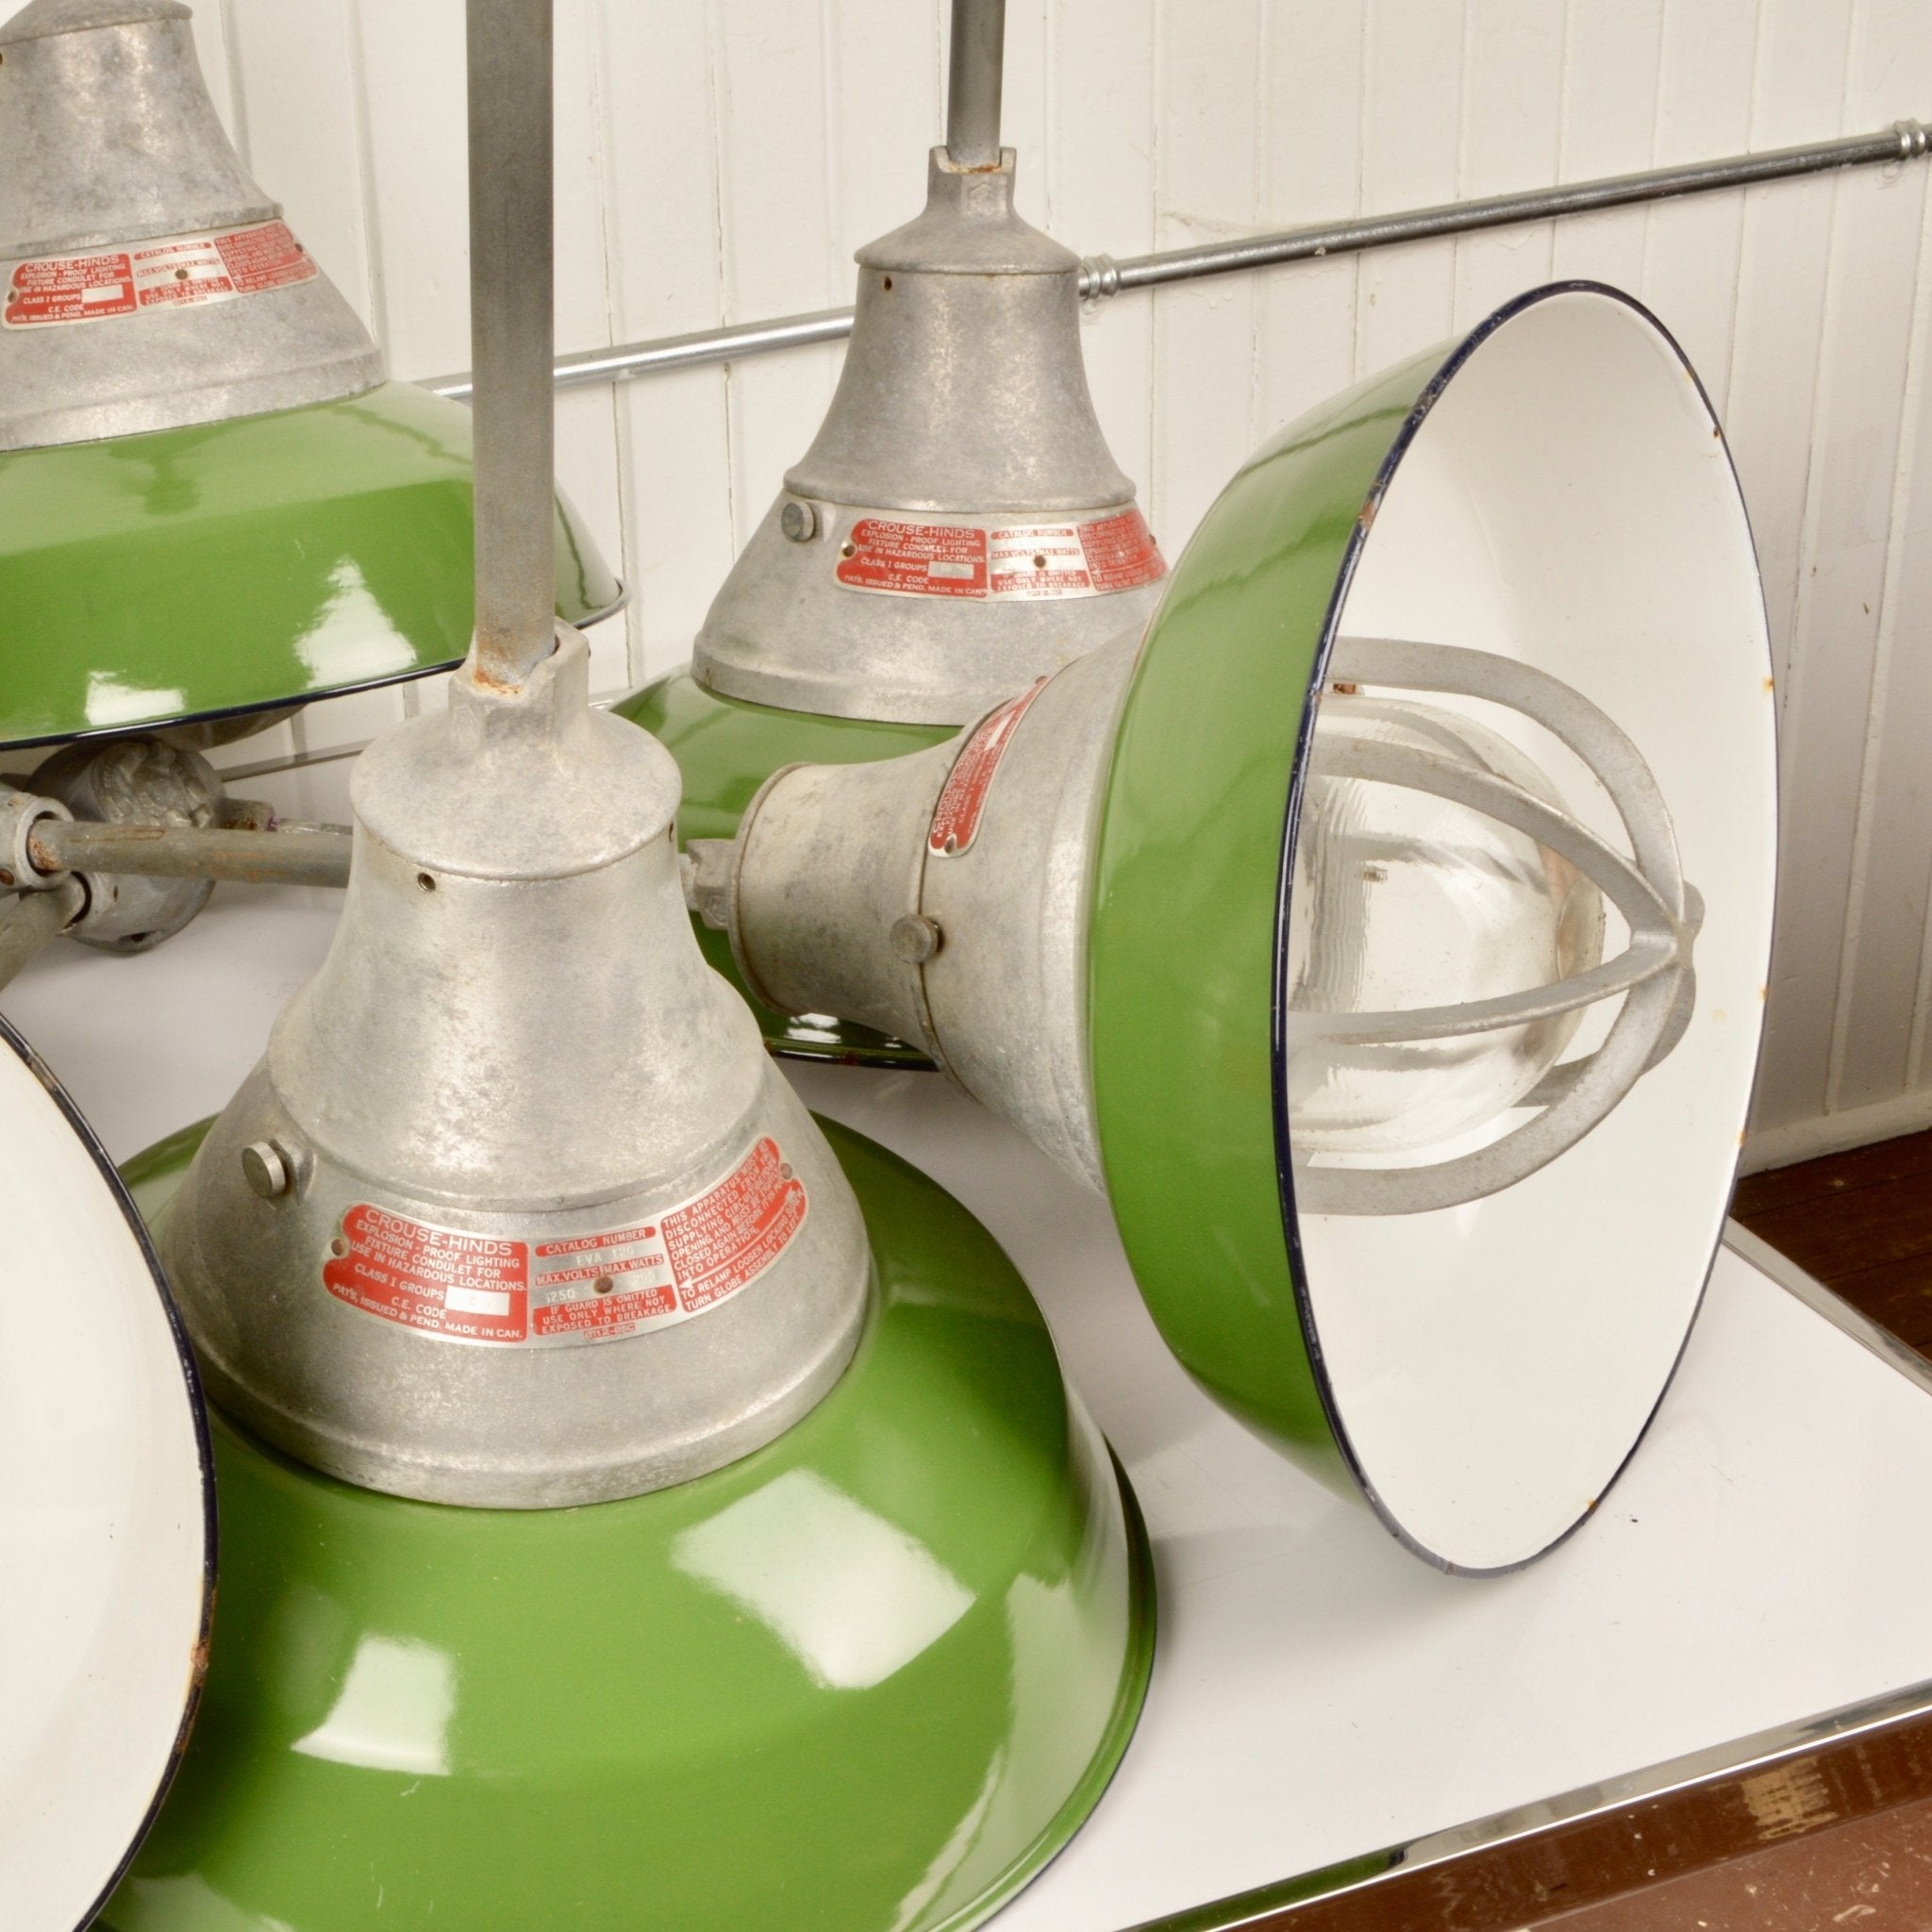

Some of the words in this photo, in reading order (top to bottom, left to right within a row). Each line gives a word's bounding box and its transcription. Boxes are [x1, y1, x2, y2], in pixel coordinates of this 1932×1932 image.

[25, 255, 120, 272] CROUSE-HINDS
[868, 521, 974, 539] CROUSE-HINDS
[663, 1211, 687, 1227] THIS
[692, 1175, 741, 1215] APPARATUS
[665, 1191, 740, 1240] DISCONNECTED
[357, 1220, 413, 1249] EXPLOSION
[423, 1245, 461, 1262] PROOF
[466, 1255, 520, 1268] LIGHTING
[366, 1209, 511, 1256] CROUSE-HINDS
[546, 1238, 598, 1255] CATALOG
[603, 1230, 646, 1245] NUMBER
[669, 1215, 724, 1251] SUPPLYING
[715, 1222, 732, 1238] AND
[351, 1241, 372, 1257] USE
[374, 1251, 385, 1264] IN
[388, 1258, 455, 1283] HAZARDOUS
[365, 1236, 408, 1260] FIXTURE
[412, 1254, 472, 1275] CONDULET
[477, 1267, 501, 1279] FOR
[674, 1247, 711, 1271] CLOSED
[712, 1230, 736, 1253] AGAIN
[355, 1263, 389, 1283] CLASS
[400, 1281, 445, 1301] GROUPS
[677, 1264, 704, 1281] INTO
[681, 1289, 696, 1300] TO
[698, 1268, 732, 1293] RELAMP
[732, 1243, 763, 1274] LOOSEN
[543, 1314, 564, 1324] USE
[570, 1308, 597, 1321] ONLY
[604, 1302, 640, 1314] WHERE
[645, 1295, 666, 1307] NOT
[566, 1300, 598, 1313] GUARD
[603, 1297, 613, 1306] IS
[616, 1289, 658, 1302] OMITTED
[685, 1292, 711, 1311] TURN
[714, 1274, 742, 1298] GLOBE
[360, 1296, 398, 1317] ISSUED
[399, 1311, 408, 1321] &
[445, 1321, 477, 1336] MADE
[481, 1327, 493, 1336] IN
[496, 1329, 523, 1339] CAN.
[415, 1304, 447, 1319] CODE
[541, 1321, 591, 1335] EXPOSED
[598, 1315, 611, 1325] TO
[617, 1304, 672, 1322] BREAKAGE
